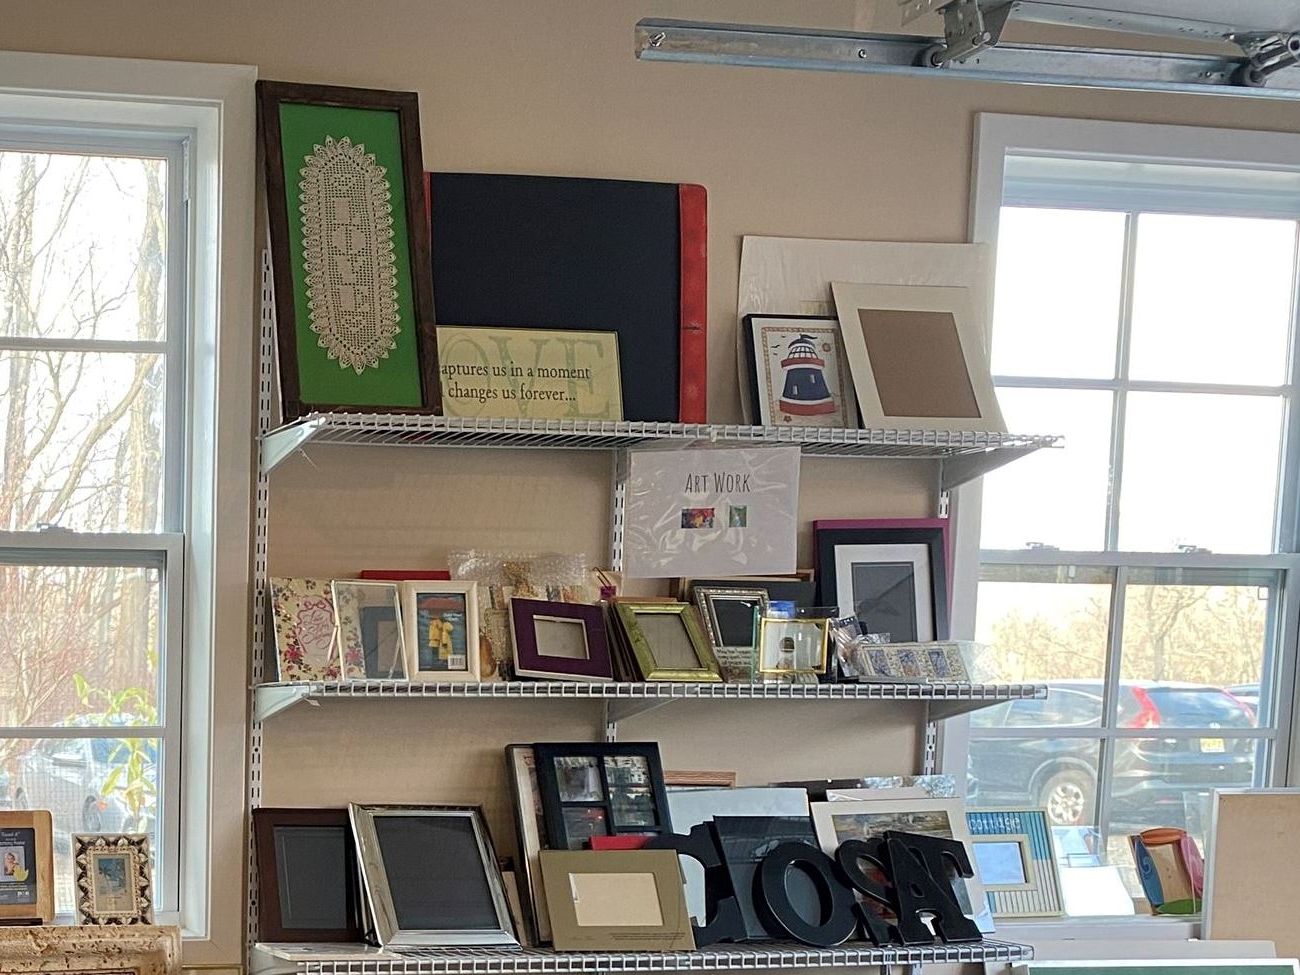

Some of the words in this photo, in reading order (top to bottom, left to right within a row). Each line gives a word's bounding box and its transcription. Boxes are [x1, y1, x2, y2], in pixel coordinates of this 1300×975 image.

[441, 362, 489, 381] aptures
[492, 366, 508, 378] us
[511, 360, 524, 378] in
[527, 367, 535, 378] a
[537, 367, 591, 380] moment
[448, 381, 498, 403] changes
[502, 386, 517, 400] us
[520, 382, 577, 402] forever...
[684, 473, 709, 494] ART
[714, 471, 751, 494] WORK
